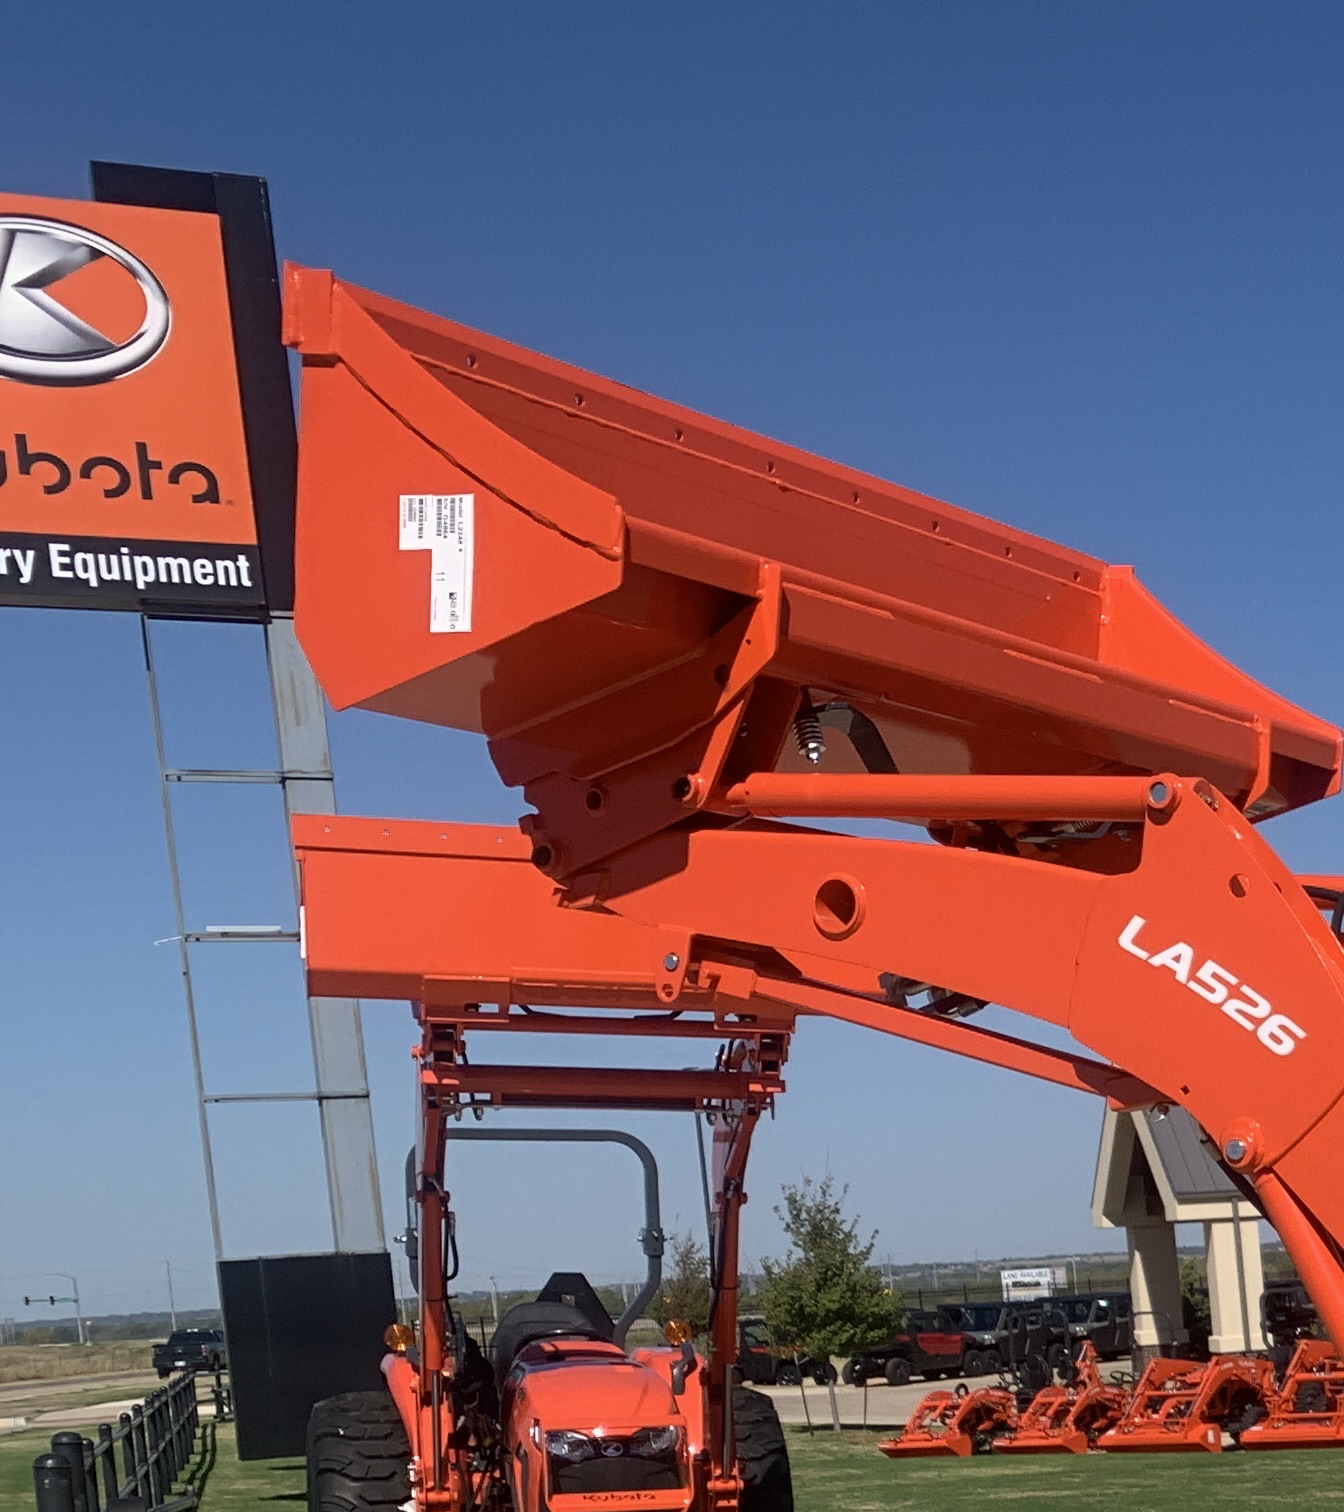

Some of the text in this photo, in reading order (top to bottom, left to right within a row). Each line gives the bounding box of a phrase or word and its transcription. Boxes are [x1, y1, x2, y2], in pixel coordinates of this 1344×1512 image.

[48, 542, 252, 590] Equipment
[1117, 914, 1308, 1057] LA526
[583, 1493, 656, 1502] Kubota
